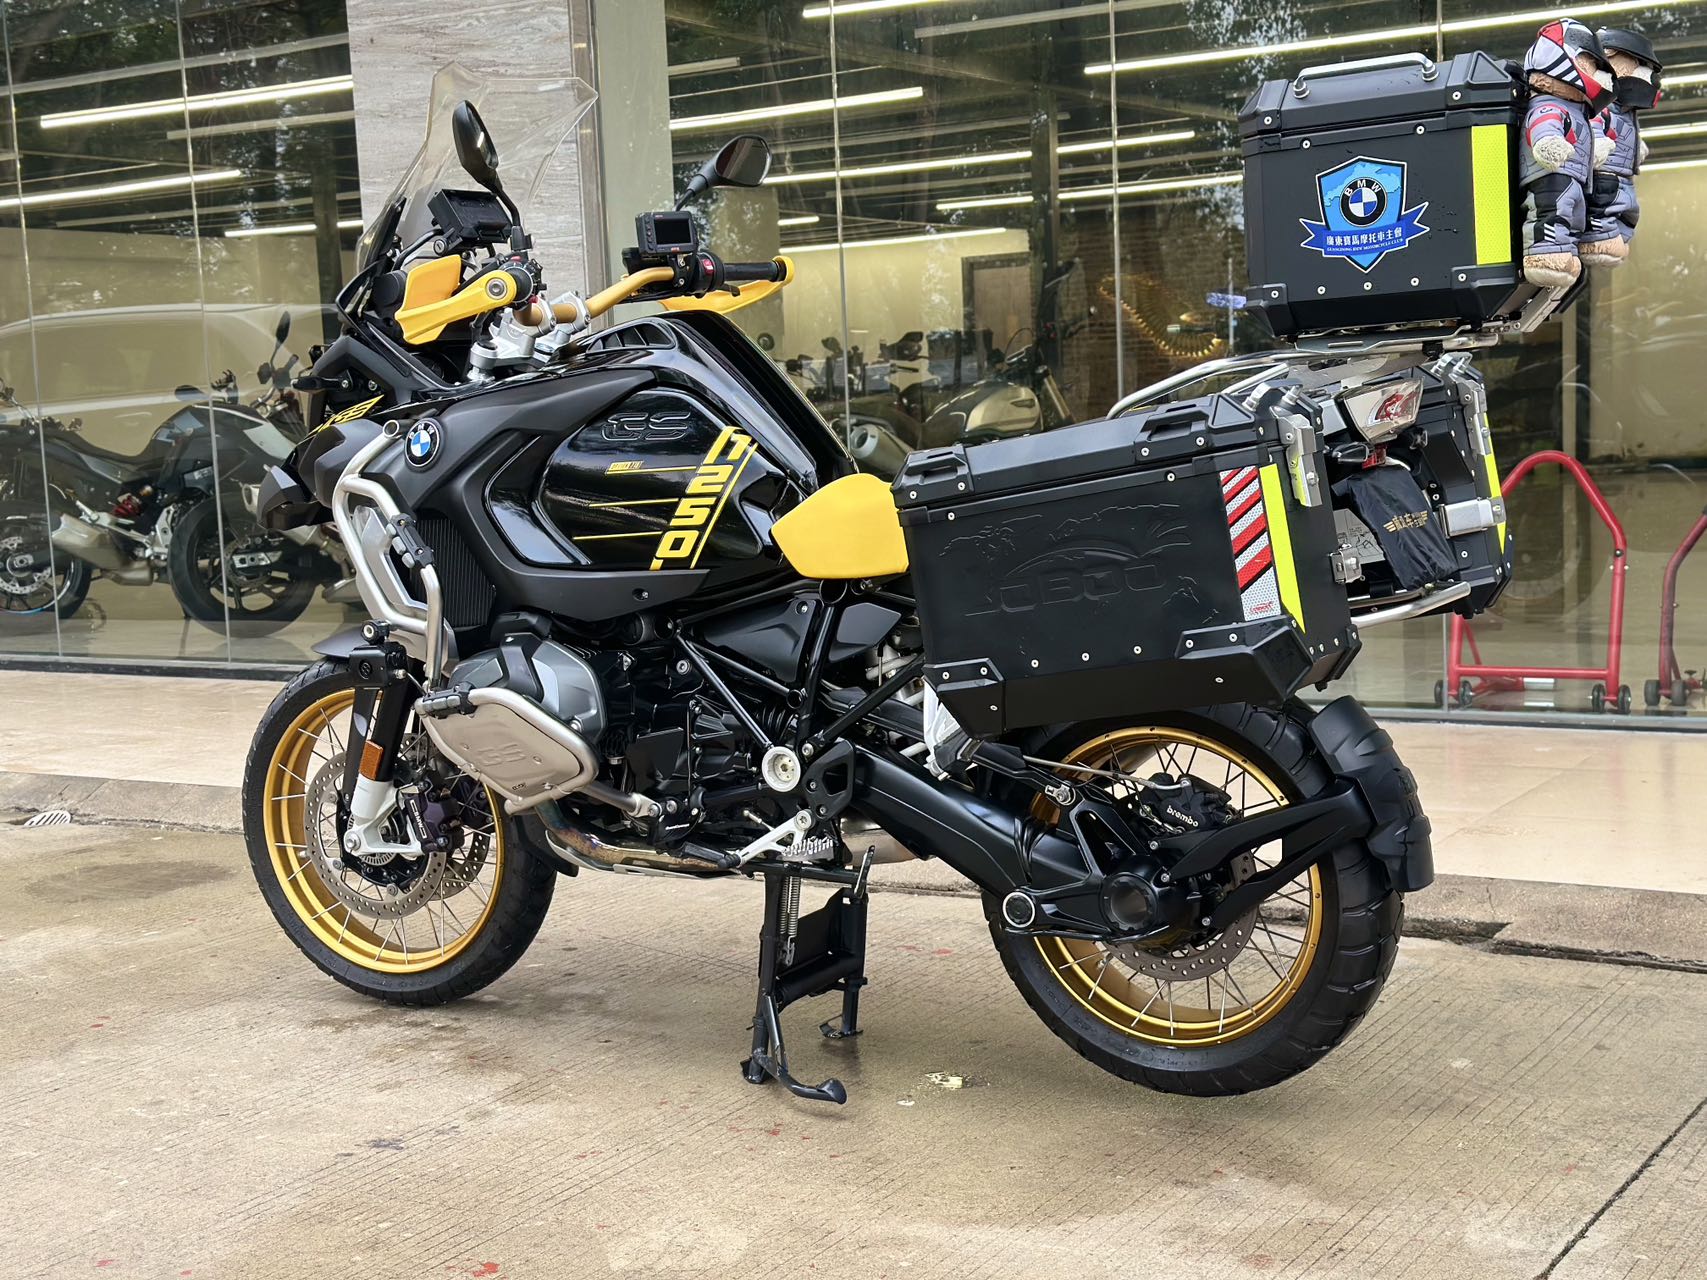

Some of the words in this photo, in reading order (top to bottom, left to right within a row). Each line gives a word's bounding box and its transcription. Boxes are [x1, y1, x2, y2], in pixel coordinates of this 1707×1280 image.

[1344, 179, 1382, 197] BMW
[408, 423, 436, 440] BMW
[601, 411, 691, 441] GS
[656, 431, 752, 559] 1250
[413, 811, 424, 829] BMW
[1166, 804, 1200, 828] brembo
